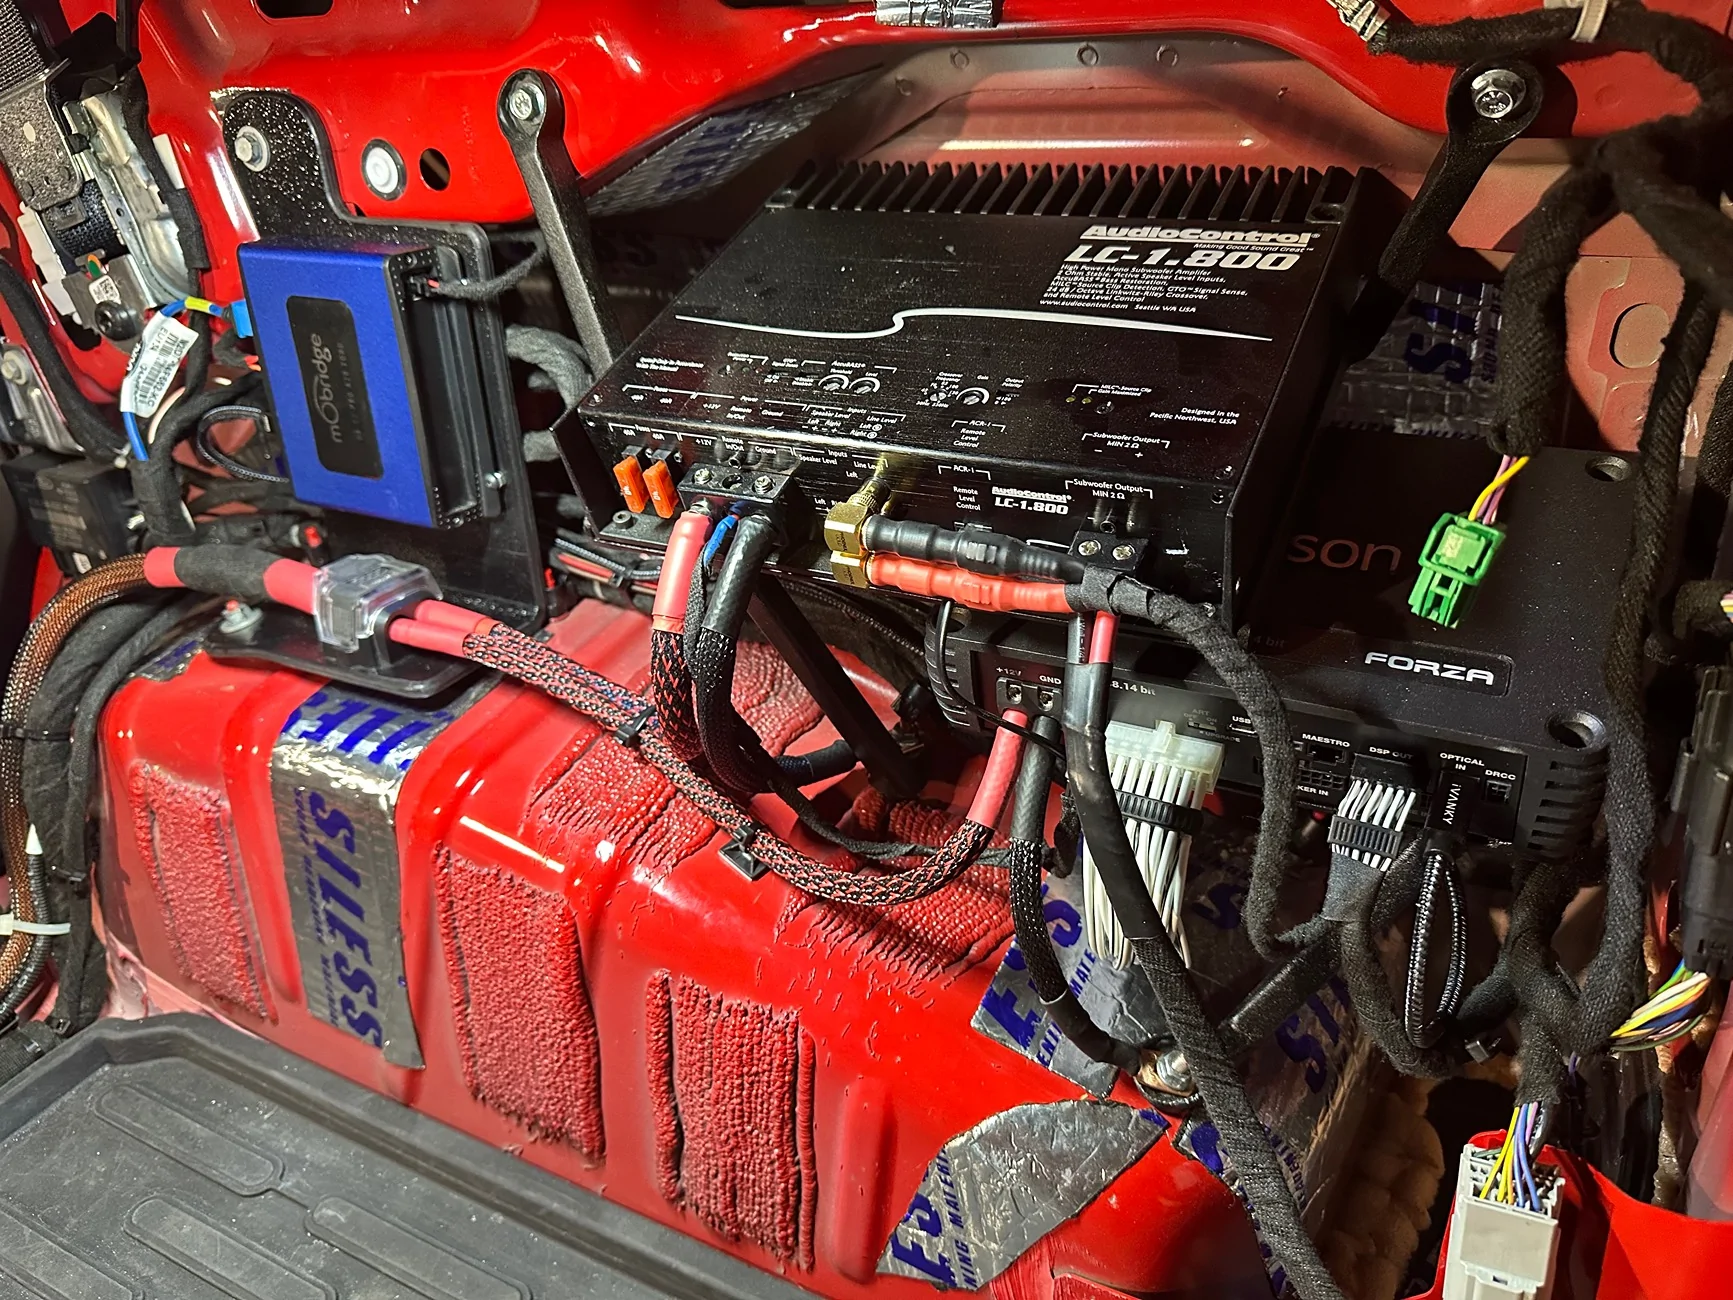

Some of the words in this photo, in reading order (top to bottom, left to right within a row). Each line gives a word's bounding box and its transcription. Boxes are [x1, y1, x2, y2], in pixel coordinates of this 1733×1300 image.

[1064, 245, 1300, 270] LC-1.800
[1060, 263, 1079, 271] High
[1039, 300, 1129, 309] www.audiocontrol.com
[1181, 407, 1216, 416] Designed
[866, 414, 880, 423] Line
[880, 416, 898, 425] Level
[1174, 414, 1217, 424] Northwest,
[960, 427, 986, 436] Remote
[1092, 432, 1132, 442] Subwoofer
[1132, 436, 1161, 445] Output
[953, 440, 980, 448] Control
[1106, 440, 1124, 448] MIN
[853, 460, 868, 469] Line
[953, 464, 975, 474] ACR-1
[953, 485, 979, 496] Remote
[1072, 478, 1114, 490] Subwoofer
[1114, 483, 1144, 493] Output
[958, 493, 976, 503] Level
[1092, 489, 1110, 498] MIN
[1110, 491, 1116, 499] 2
[956, 501, 981, 511] Control
[994, 496, 1069, 515] LC-1.800
[1287, 534, 1402, 571] son
[995, 667, 1022, 677] +12V
[1364, 651, 1495, 686] FORZA
[1039, 674, 1062, 685] GND
[1110, 680, 1138, 692] 8.14
[1140, 685, 1156, 696] bit
[1302, 733, 1351, 748] MAESTRO
[1369, 746, 1391, 755] DSP
[1439, 752, 1485, 767] OPTICAL
[1455, 763, 1467, 772] IN
[1485, 769, 1517, 781] DRCC
[935, 1144, 966, 1229] MATERI
